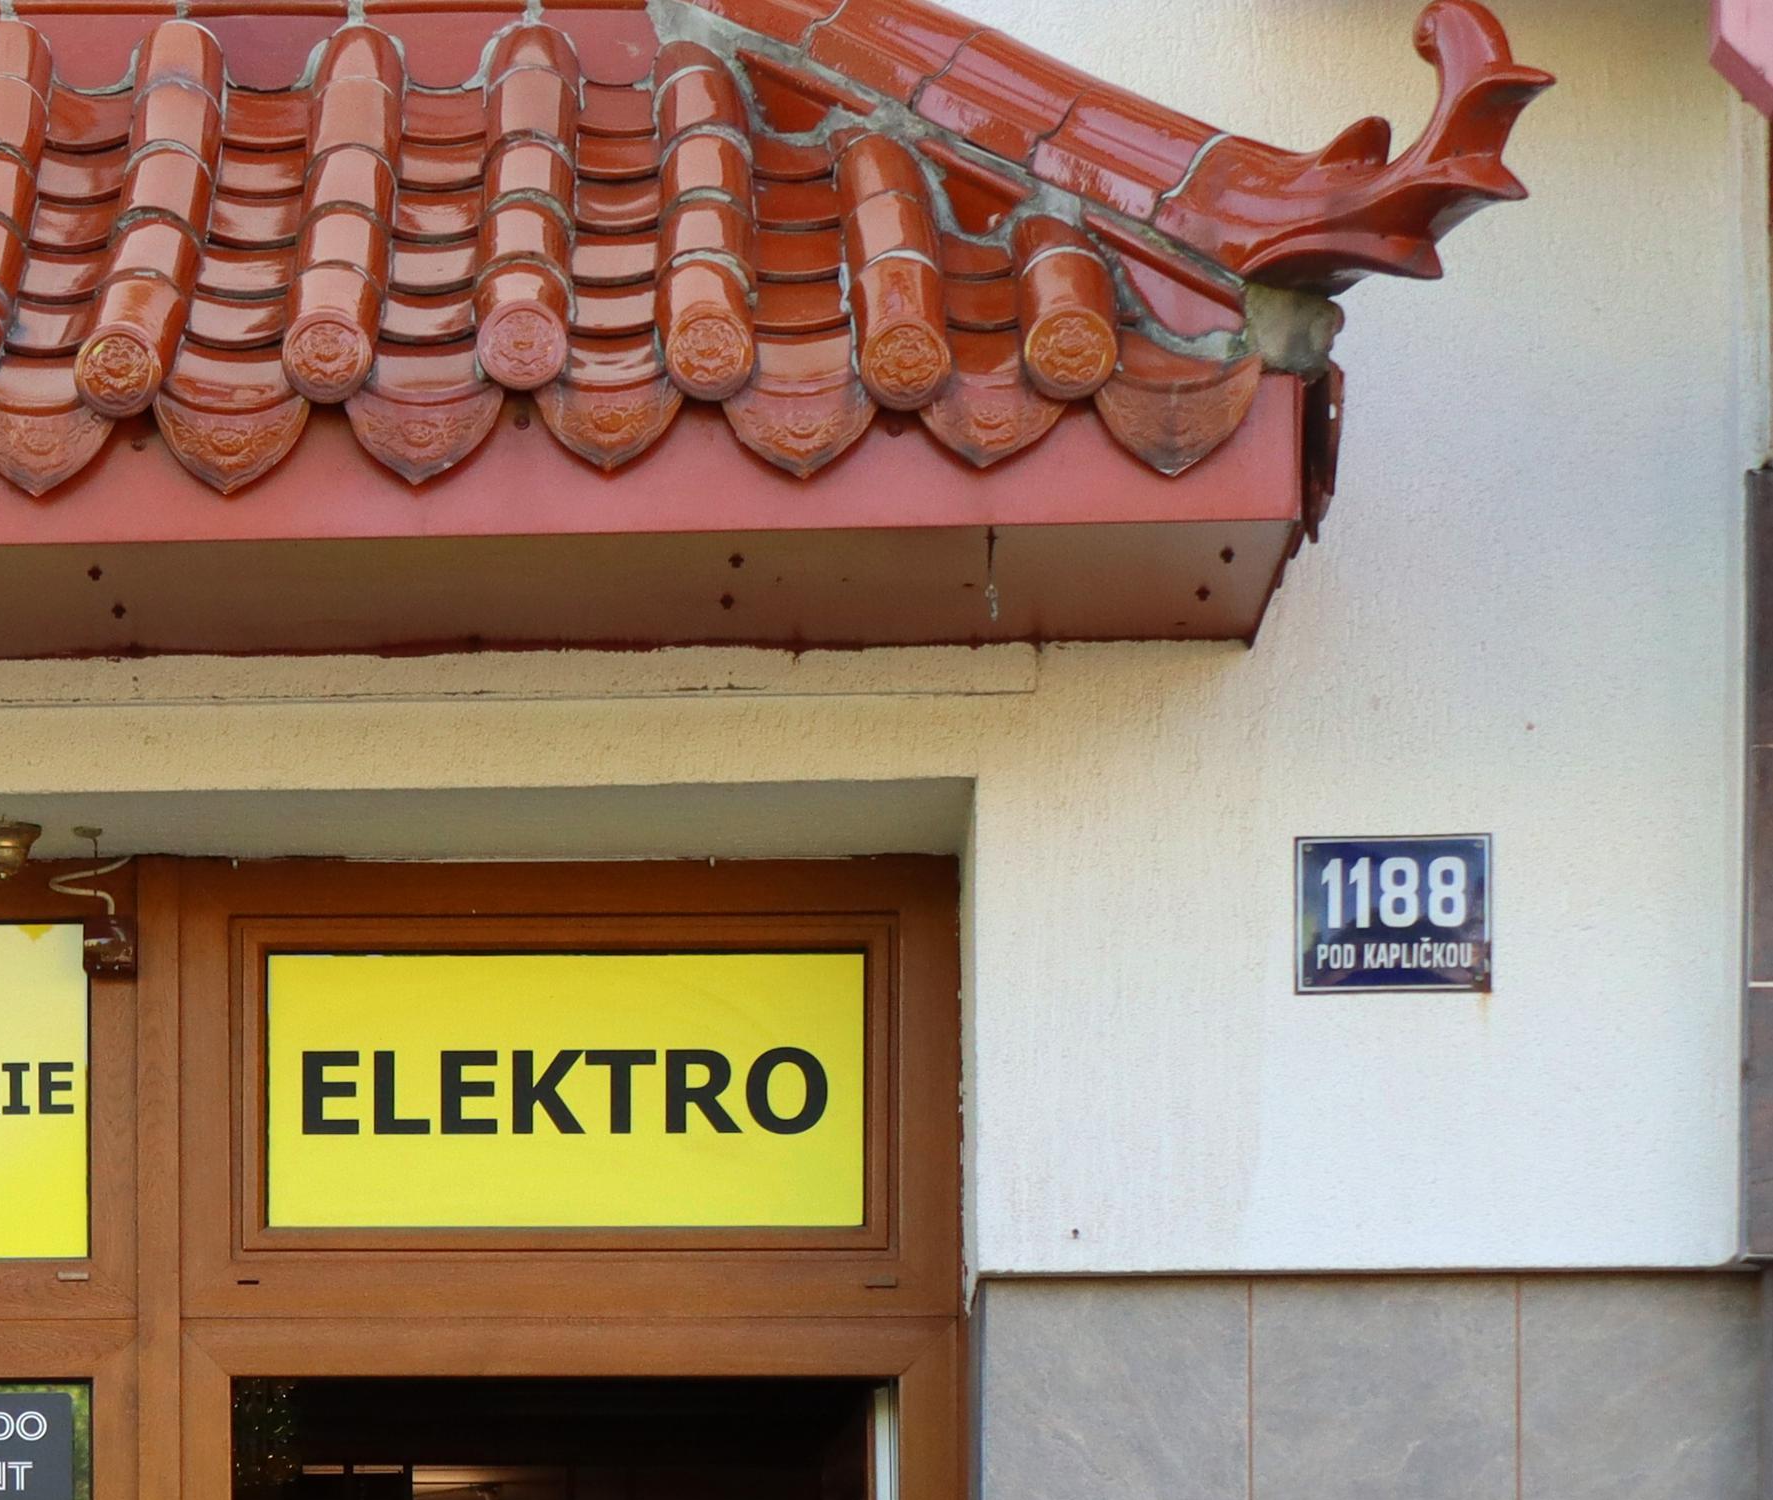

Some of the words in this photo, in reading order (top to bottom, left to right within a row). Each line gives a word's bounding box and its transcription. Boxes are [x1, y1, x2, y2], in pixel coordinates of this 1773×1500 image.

[1321, 856, 1467, 929] 1188
[1316, 943, 1356, 970] POD
[1363, 936, 1473, 969] KAPLIČKOU
[300, 1046, 830, 1136] ELEKTRO
